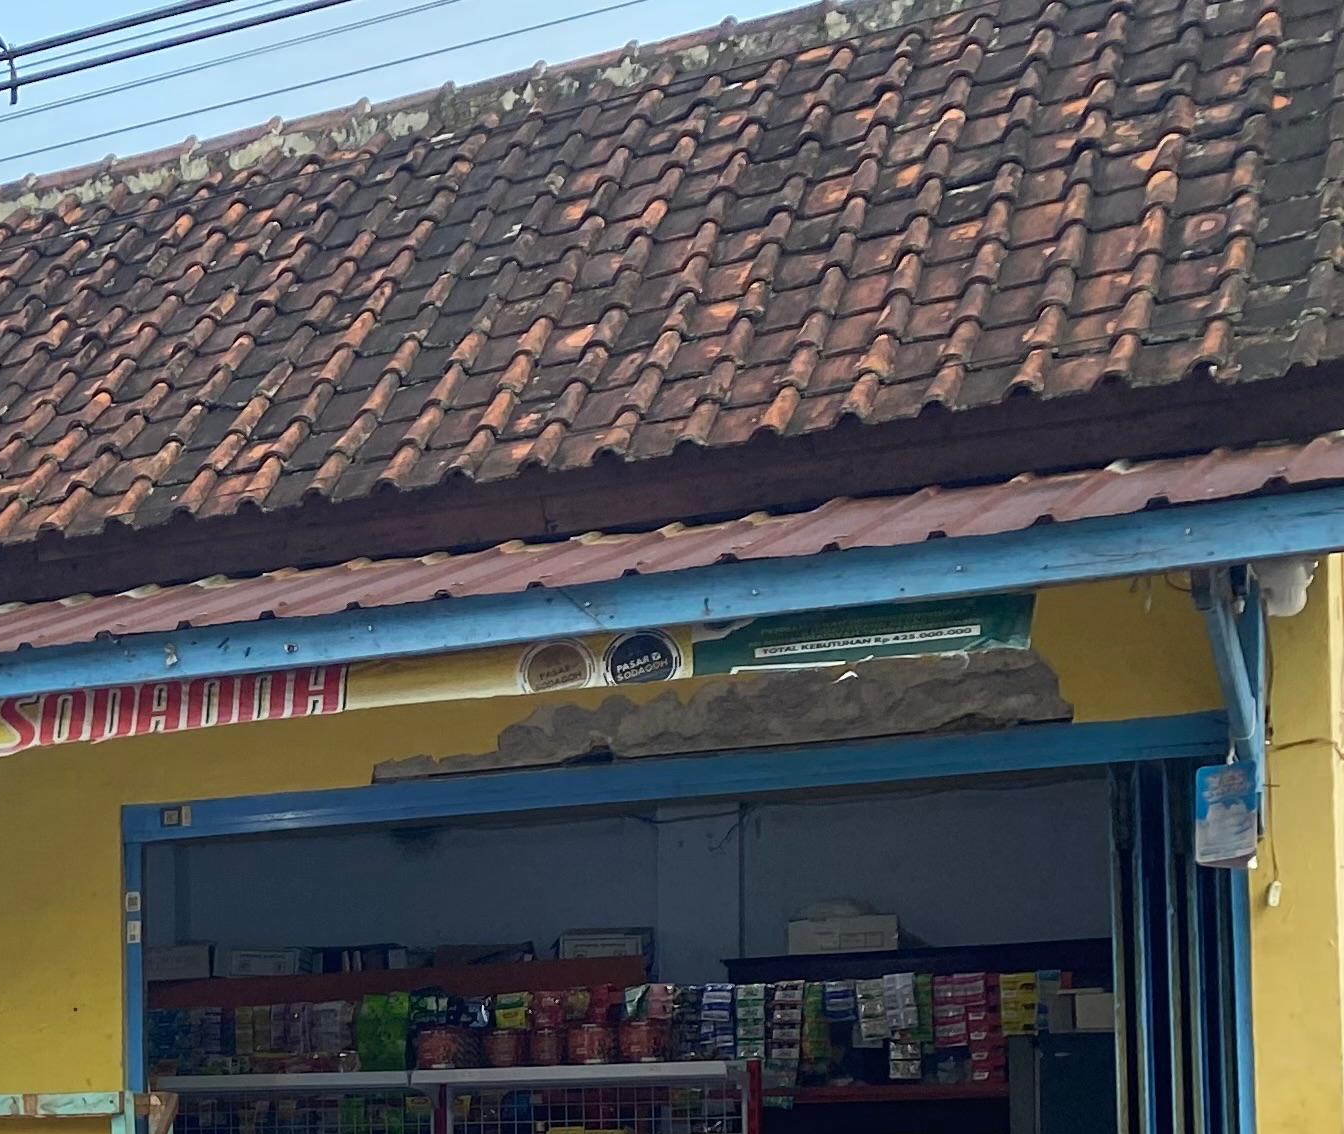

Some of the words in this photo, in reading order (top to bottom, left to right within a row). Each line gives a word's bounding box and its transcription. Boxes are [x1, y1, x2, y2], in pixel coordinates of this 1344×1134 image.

[763, 643, 798, 655] TOTAL
[800, 636, 872, 651] KEBUTUHAN
[874, 634, 891, 645] Rp
[615, 655, 650, 674] PASAR
